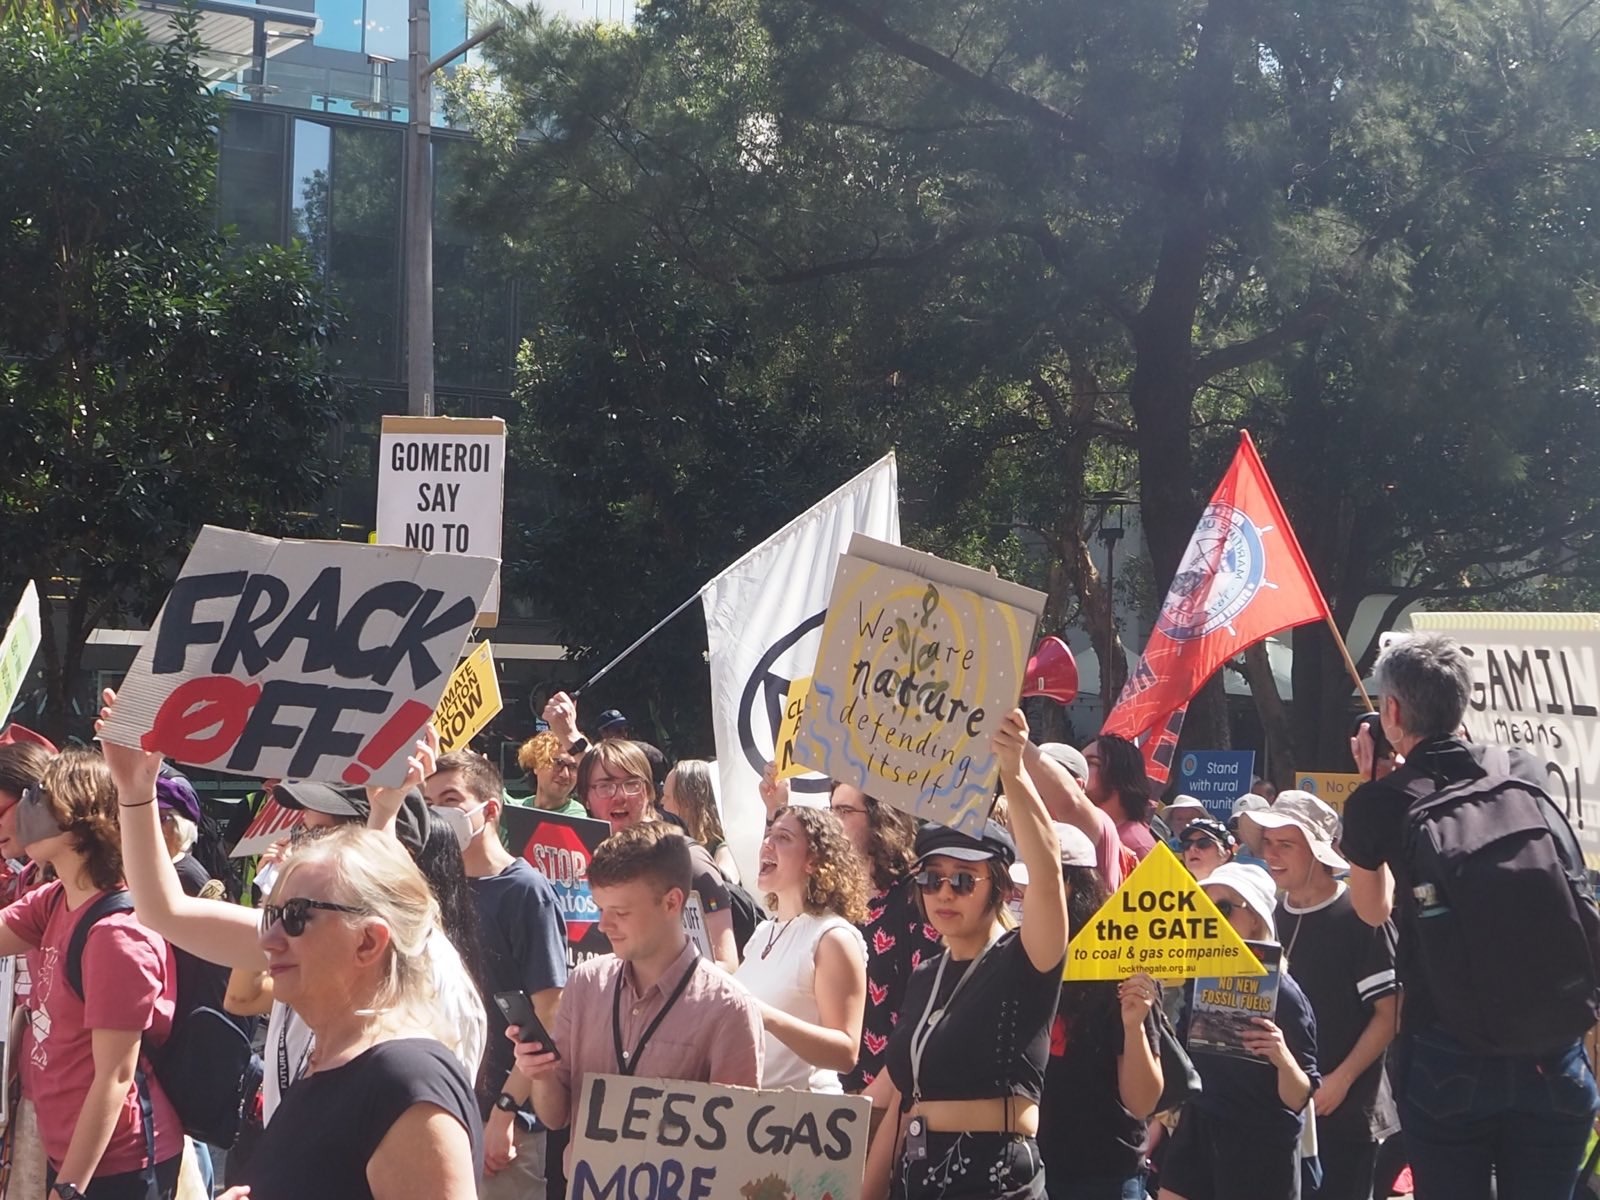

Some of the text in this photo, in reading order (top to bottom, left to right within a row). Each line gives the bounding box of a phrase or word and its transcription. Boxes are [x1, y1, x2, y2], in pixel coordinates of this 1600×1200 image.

[391, 442, 490, 472] GOMEROI
[417, 482, 461, 512] SAY
[405, 522, 469, 553] NO TO
[152, 566, 476, 690] FRACK
[859, 600, 974, 670] We are
[433, 661, 474, 727] LIMATE
[439, 671, 478, 732] ACTION
[438, 683, 483, 754] NOW
[1494, 718, 1562, 749] means
[839, 696, 971, 788] defending
[867, 747, 944, 804] itself
[1207, 761, 1239, 774] Stand
[1189, 778, 1239, 792] with rural
[1326, 781, 1344, 793] No
[532, 843, 587, 890] STOP
[1122, 890, 1197, 913] LOCK
[1095, 918, 1218, 941] the GATE
[1074, 945, 1239, 962] to coal & gas companies
[1118, 965, 1196, 974] lockthegate.org.au
[1219, 976, 1259, 994] NO NEW
[1201, 989, 1271, 1013] FOSSIL FUELS
[279, 1049, 289, 1089] FUTURE
[747, 1105, 858, 1161] GAS
[572, 1158, 717, 1200] MORE
